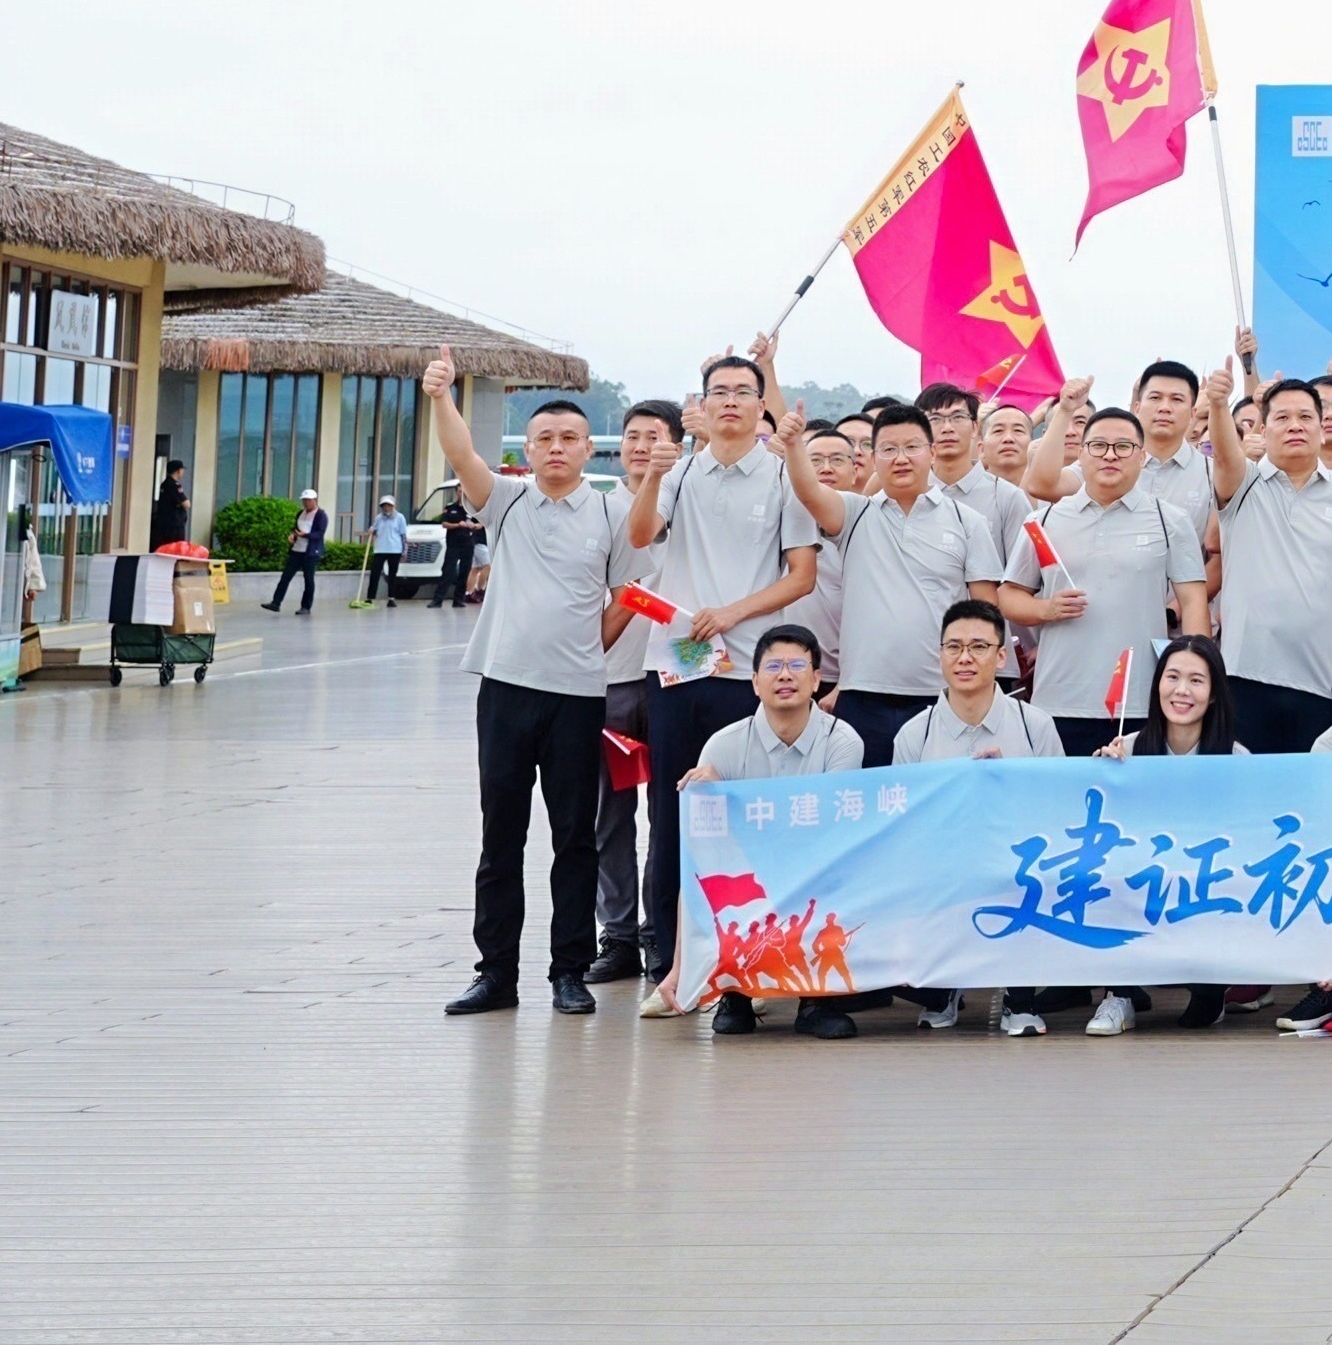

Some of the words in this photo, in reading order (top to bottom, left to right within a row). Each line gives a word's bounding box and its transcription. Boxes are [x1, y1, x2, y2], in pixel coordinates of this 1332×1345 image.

[851, 111, 967, 246] 中国工农红军第五军
[744, 782, 909, 831] 中建海峡
